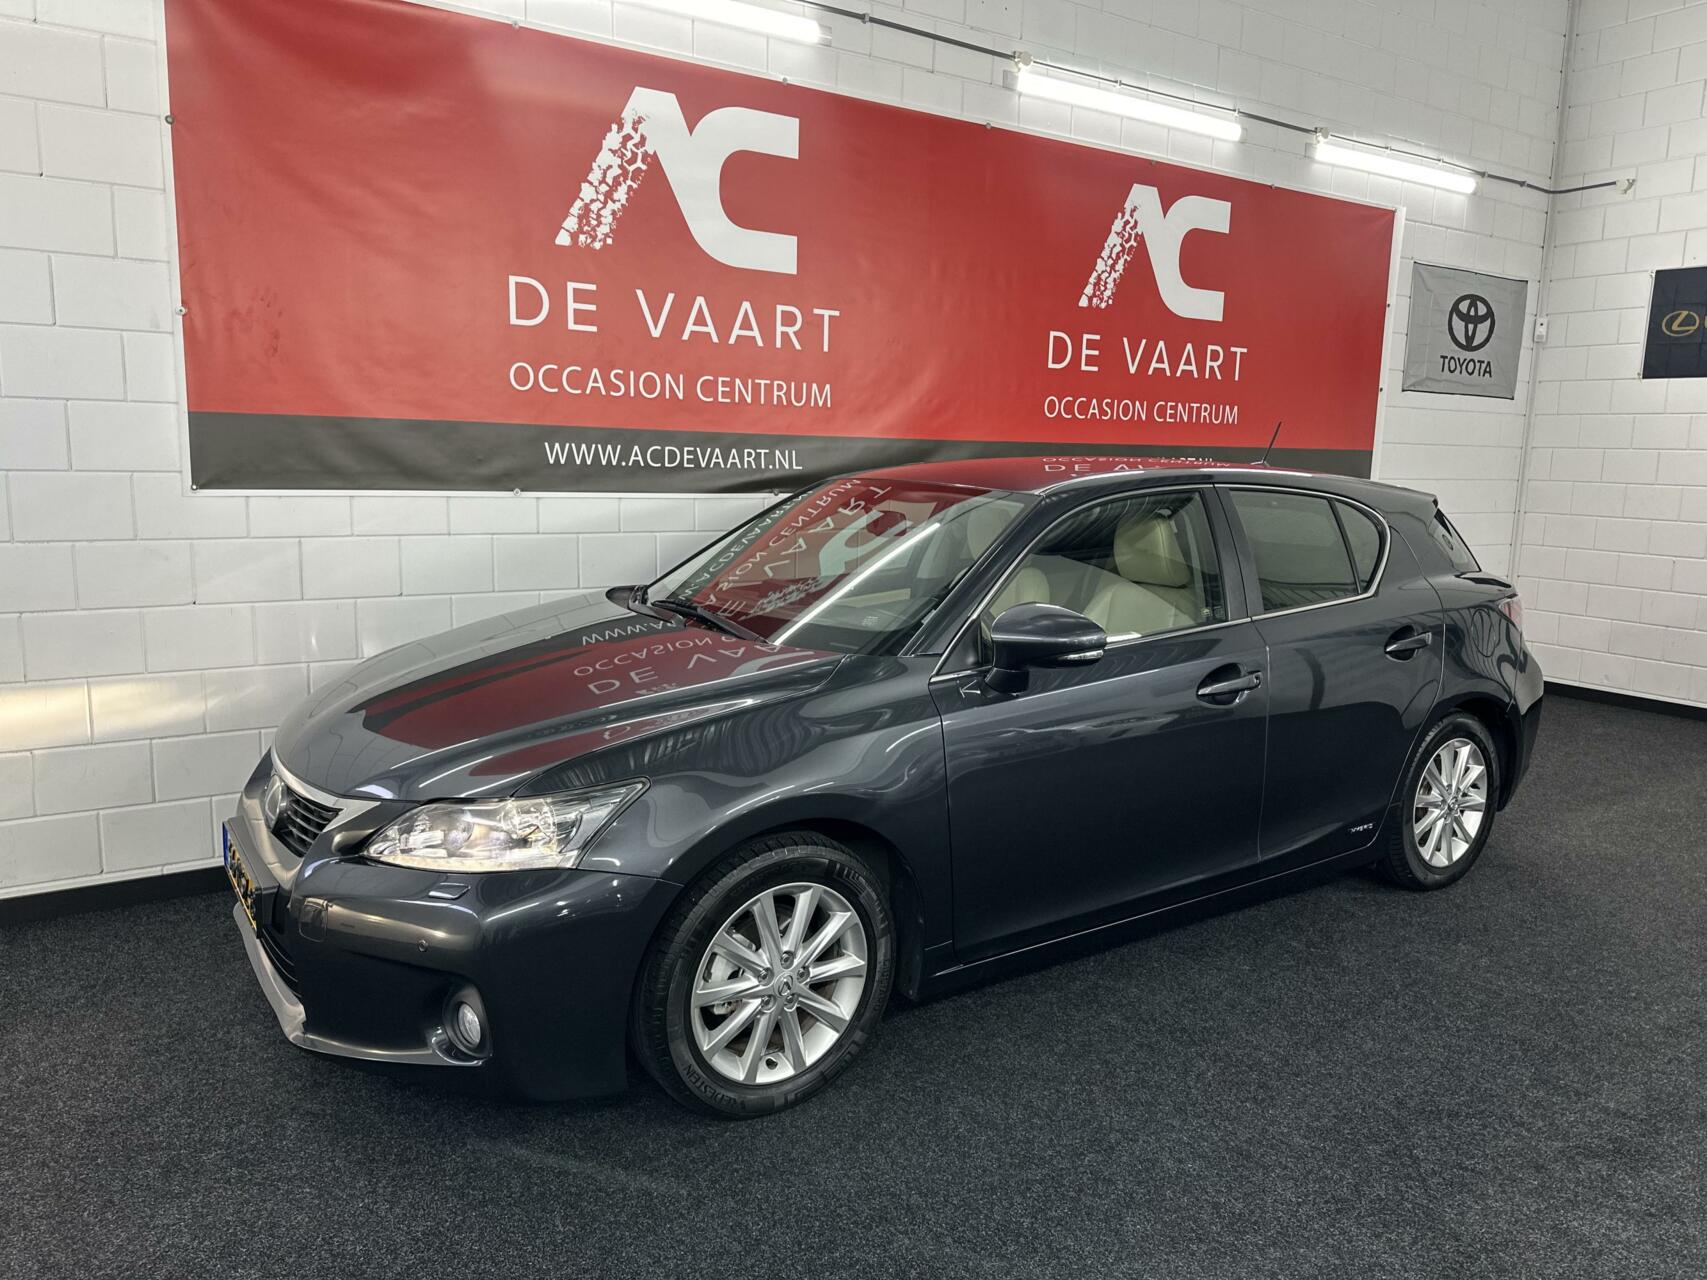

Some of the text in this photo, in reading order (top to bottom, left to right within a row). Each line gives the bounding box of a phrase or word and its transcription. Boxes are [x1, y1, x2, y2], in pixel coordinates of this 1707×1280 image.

[508, 274, 840, 353] DE VAART
[1047, 330, 1248, 381] DE VAART
[1440, 355, 1492, 378] TOYOTA
[509, 361, 832, 408] OCCASION CENTRUM
[1044, 396, 1239, 425] OCCASION CENTRUM
[544, 441, 803, 470] WWW.ACDEVAART.NL
